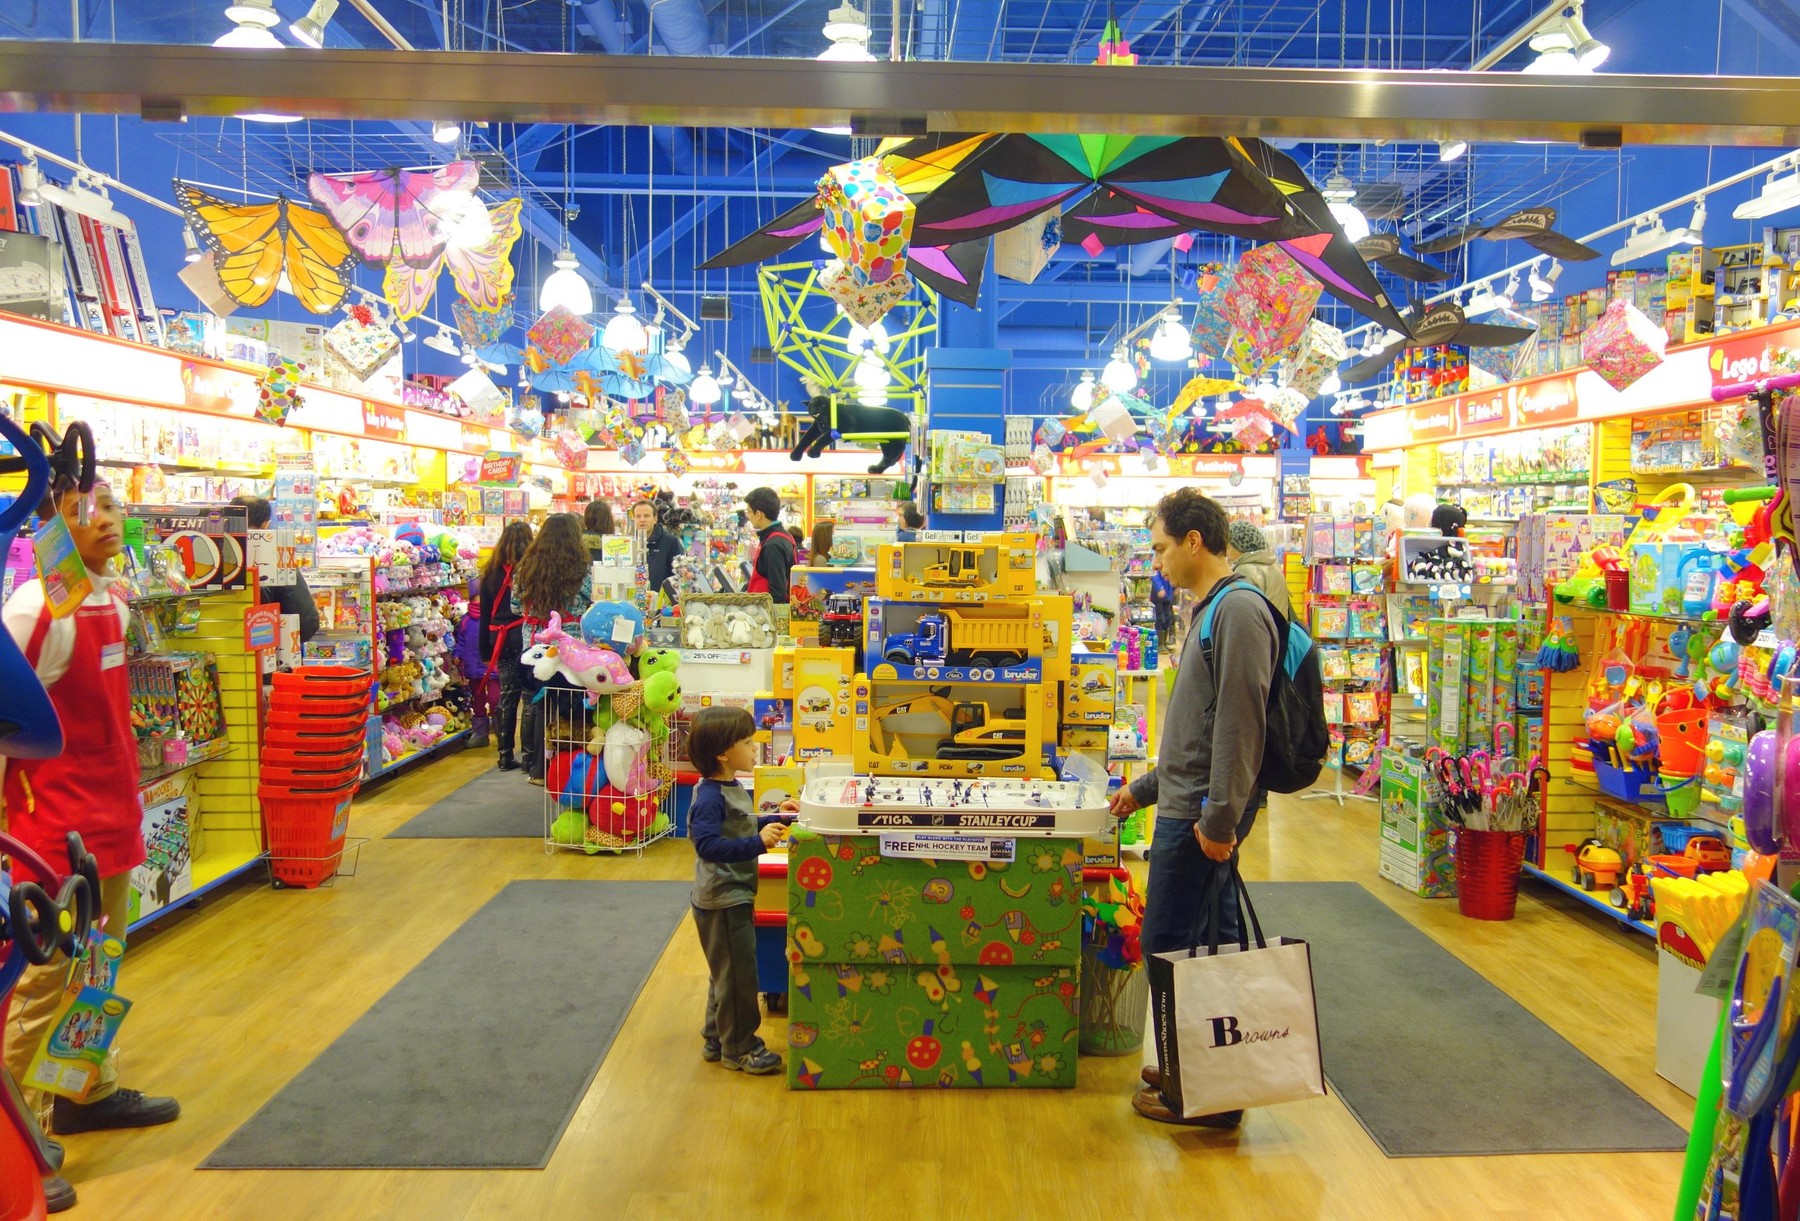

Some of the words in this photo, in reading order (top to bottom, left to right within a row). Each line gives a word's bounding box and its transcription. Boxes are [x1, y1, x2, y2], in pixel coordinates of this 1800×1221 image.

[1722, 356, 1758, 383] Lego
[483, 460, 511, 470] BIRTHDAY
[1195, 461, 1238, 473] Activity
[488, 466, 508, 475] CARDS
[171, 518, 205, 529] TENT
[1004, 669, 1038, 680] bruder
[896, 706, 908, 714] CAT
[1084, 711, 1111, 720] bruder
[800, 748, 832, 758] bruder
[868, 761, 880, 769] CAT
[1002, 764, 1025, 772] bruder
[872, 815, 913, 825] STIGA
[959, 815, 1012, 827] STANLEY
[1012, 815, 1037, 827] CUP
[885, 840, 915, 851] FREE
[915, 842, 931, 850] NHL
[933, 842, 964, 851] HOCKEY
[967, 844, 988, 852] TEAM
[1084, 855, 1114, 864] bruder
[1205, 1016, 1290, 1049] Browns
